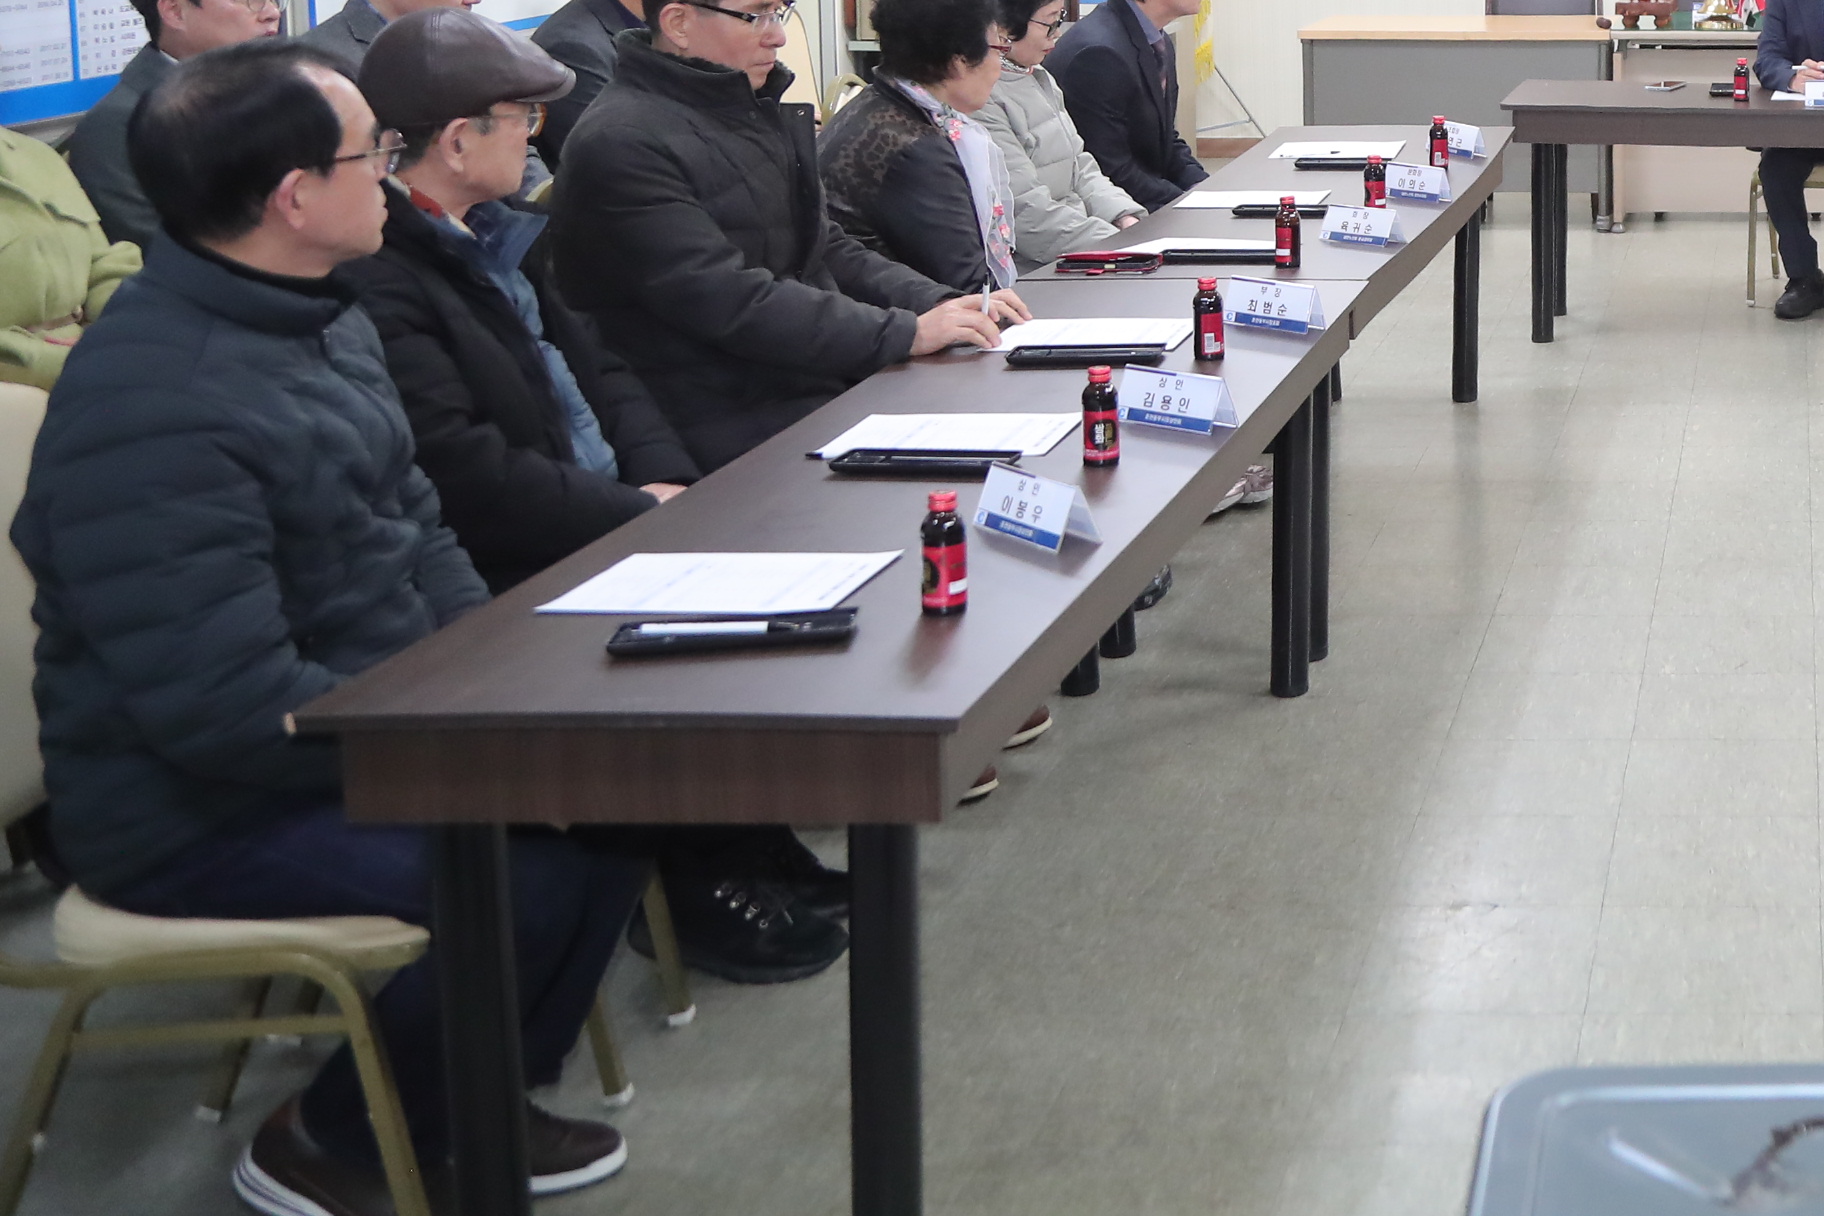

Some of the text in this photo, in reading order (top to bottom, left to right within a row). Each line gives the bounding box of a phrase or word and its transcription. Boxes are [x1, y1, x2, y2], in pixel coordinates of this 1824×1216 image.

[1247, 299, 1287, 316] 최범순
[1159, 377, 1184, 391] 상인
[1143, 392, 1190, 414] 김용인
[1019, 479, 1041, 496] 상인
[1001, 495, 1043, 523] 이봉우
